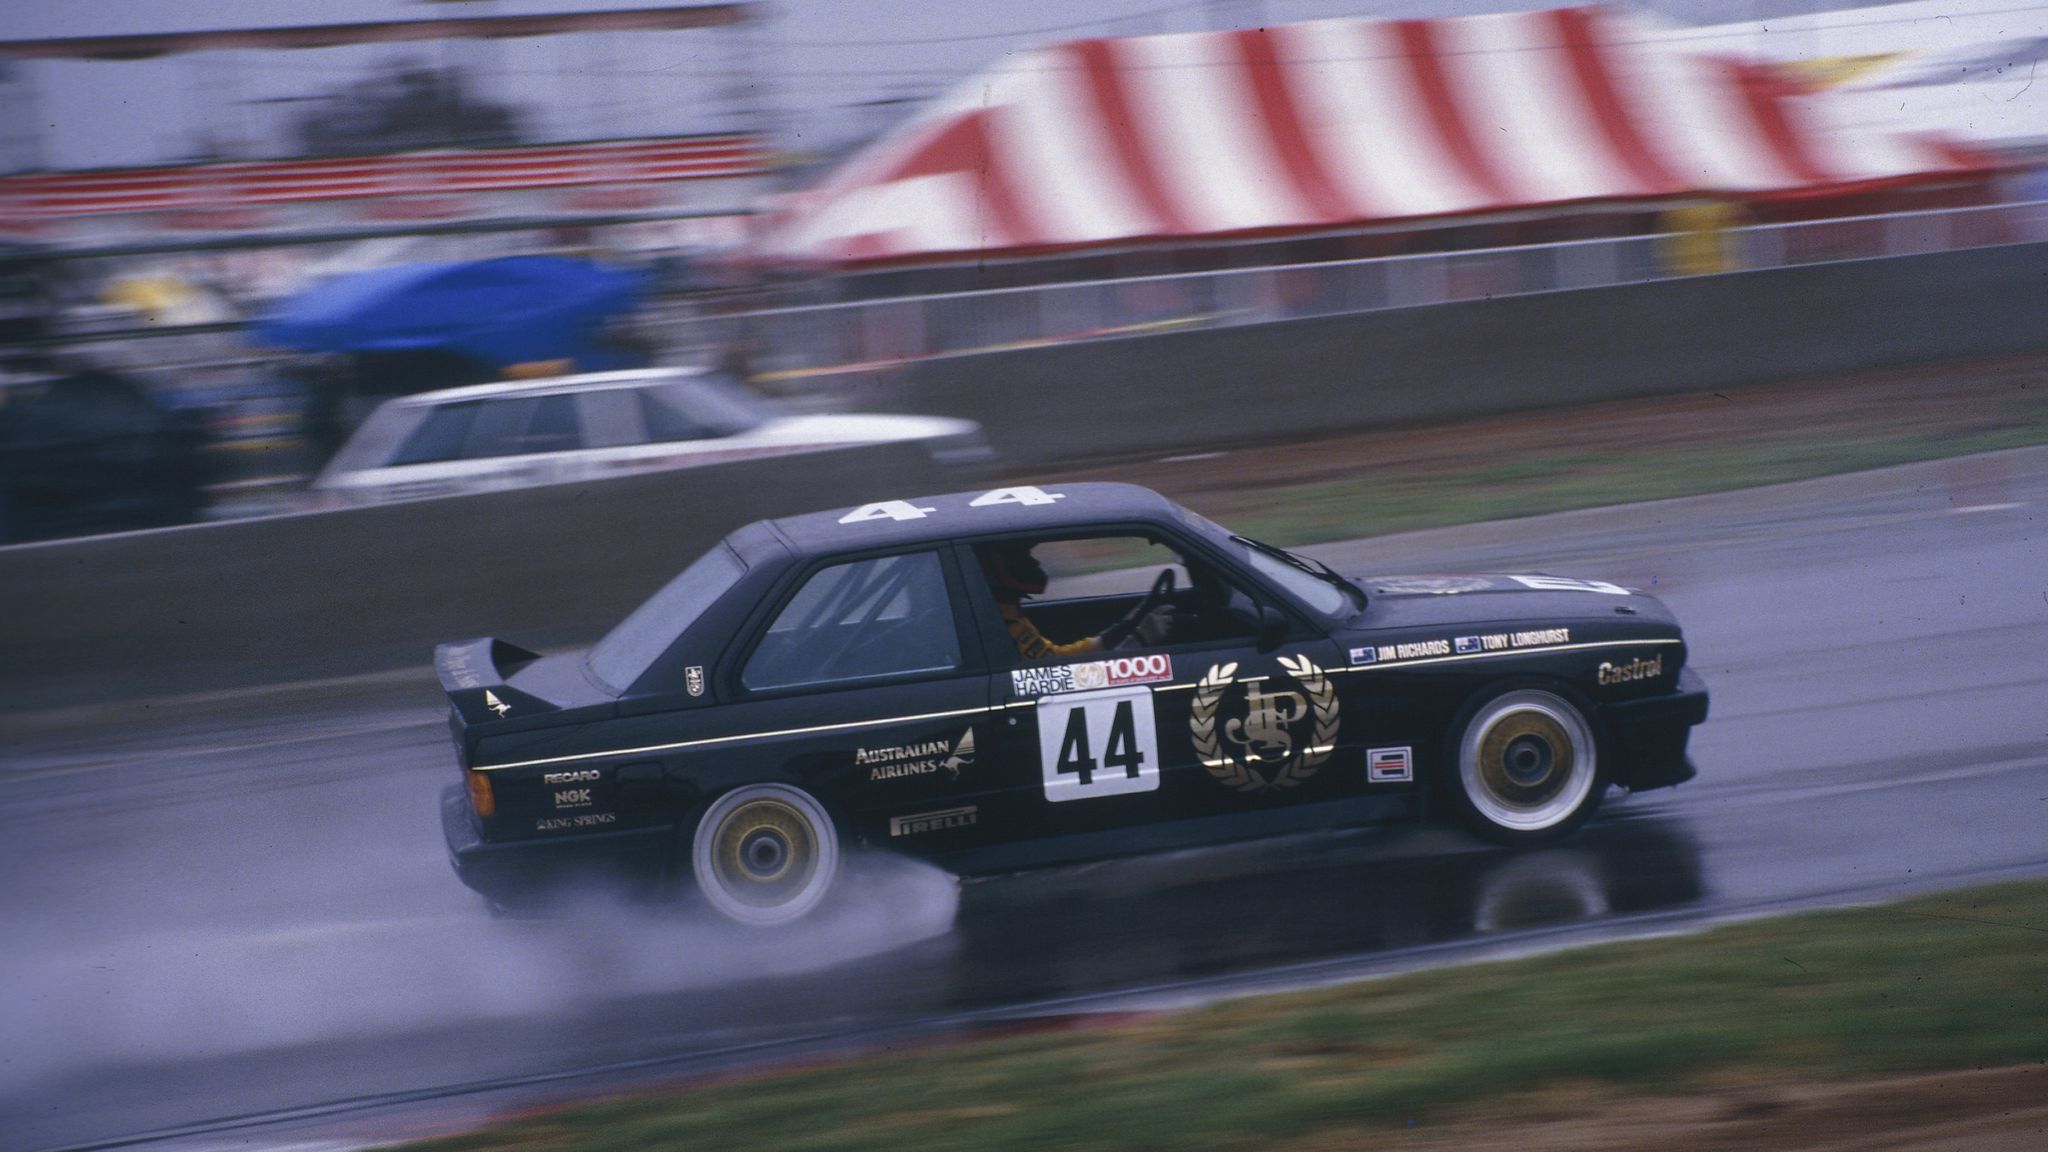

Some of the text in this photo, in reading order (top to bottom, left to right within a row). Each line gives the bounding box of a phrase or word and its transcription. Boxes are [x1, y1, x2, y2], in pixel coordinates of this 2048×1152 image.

[1378, 628, 1570, 661] JIM RICHARDS TONY LONGHURST
[1015, 665, 1072, 683] JAMES
[1105, 654, 1167, 679] 1000
[1598, 652, 1662, 686] Castrol
[1015, 677, 1075, 697] HARDIE
[855, 740, 950, 765] AUSTRALIAN
[1056, 700, 1145, 785] 44
[543, 769, 601, 784] RECARO
[871, 760, 937, 780] AIRLINES
[555, 789, 591, 804] NGK
[545, 812, 616, 830] KING SPRINGS
[890, 805, 978, 837] PIRELLI
